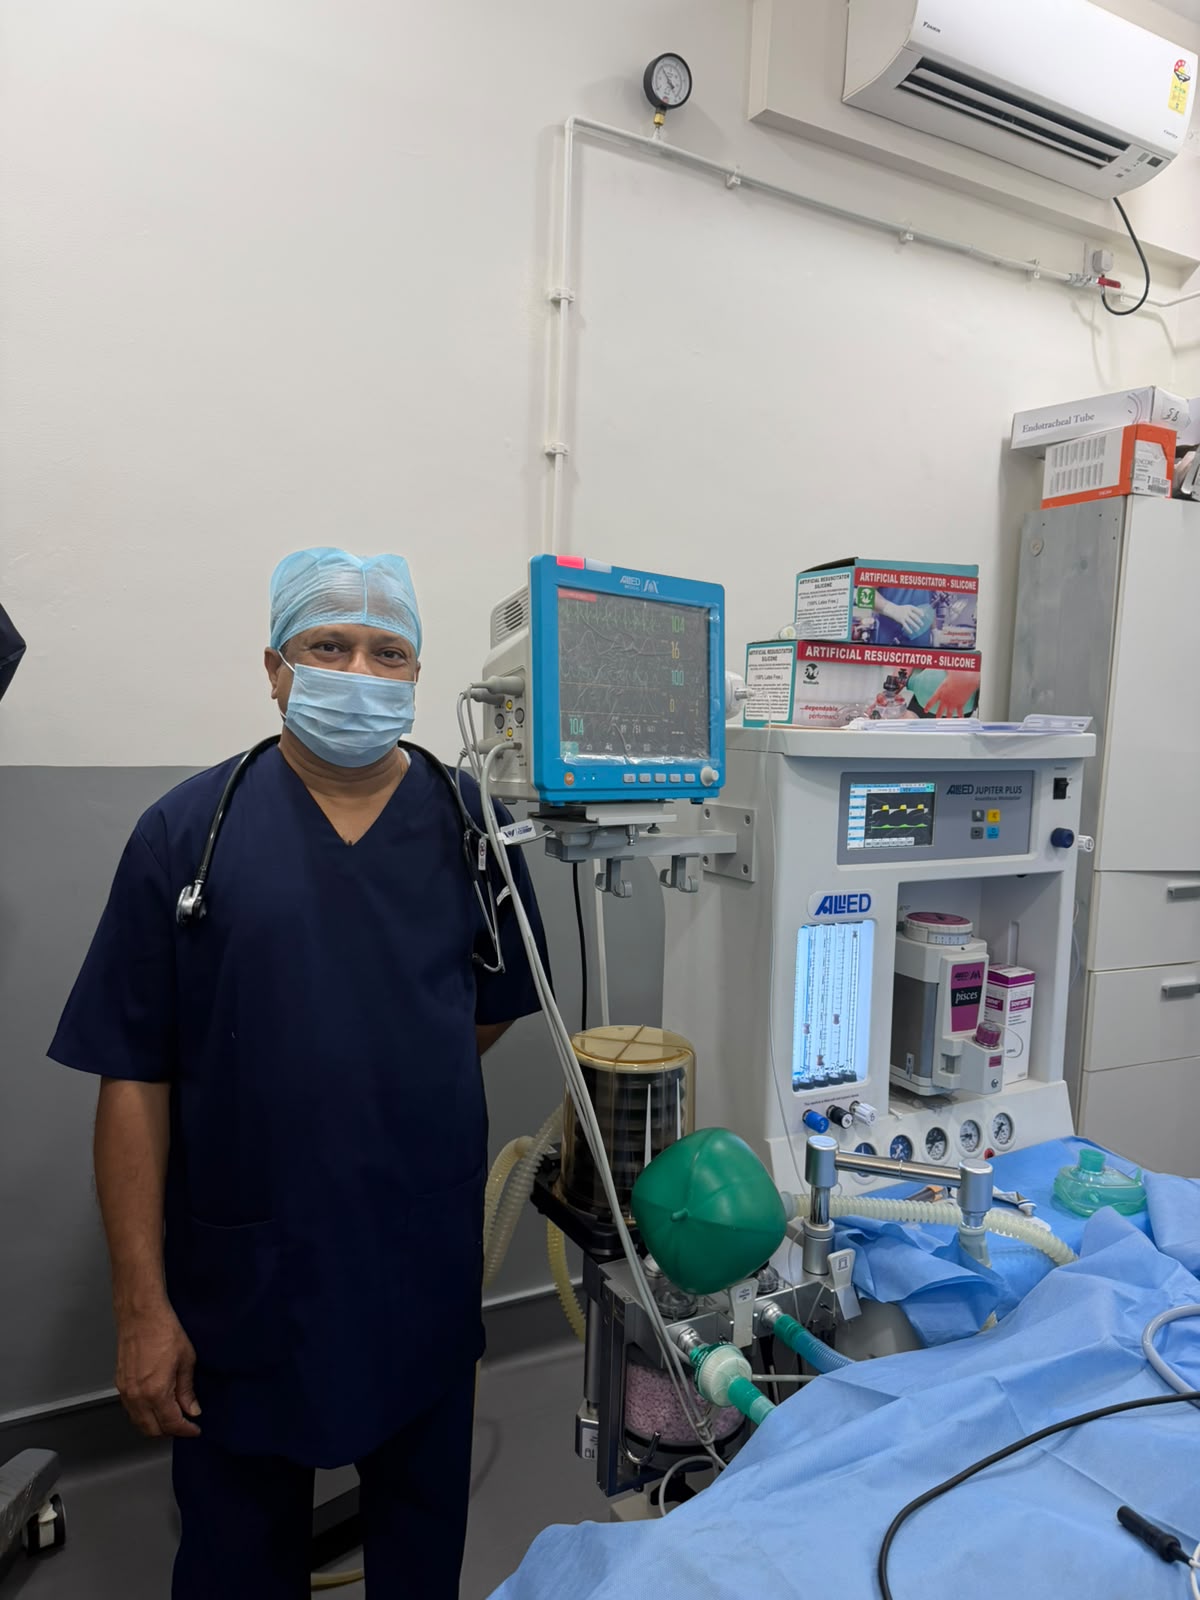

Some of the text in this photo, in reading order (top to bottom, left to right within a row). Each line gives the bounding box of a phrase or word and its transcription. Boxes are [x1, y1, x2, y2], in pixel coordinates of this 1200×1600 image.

[1022, 413, 1095, 433] Endotracheal Tube
[800, 577, 820, 585] ARTIFICIAL
[860, 572, 898, 584] ARTIFICIAL
[900, 575, 946, 587] RESUSCITATOR
[950, 579, 977, 590] SILICONE
[805, 646, 861, 660] ARTIFICIAL
[864, 650, 932, 665] RESUSCITATOR
[939, 656, 975, 669] SILICONE
[569, 717, 584, 736] 104
[946, 784, 1023, 795] ALLIED JUPITER PLUS
[814, 893, 872, 916] ALLIED
[955, 991, 978, 1005] pisces
